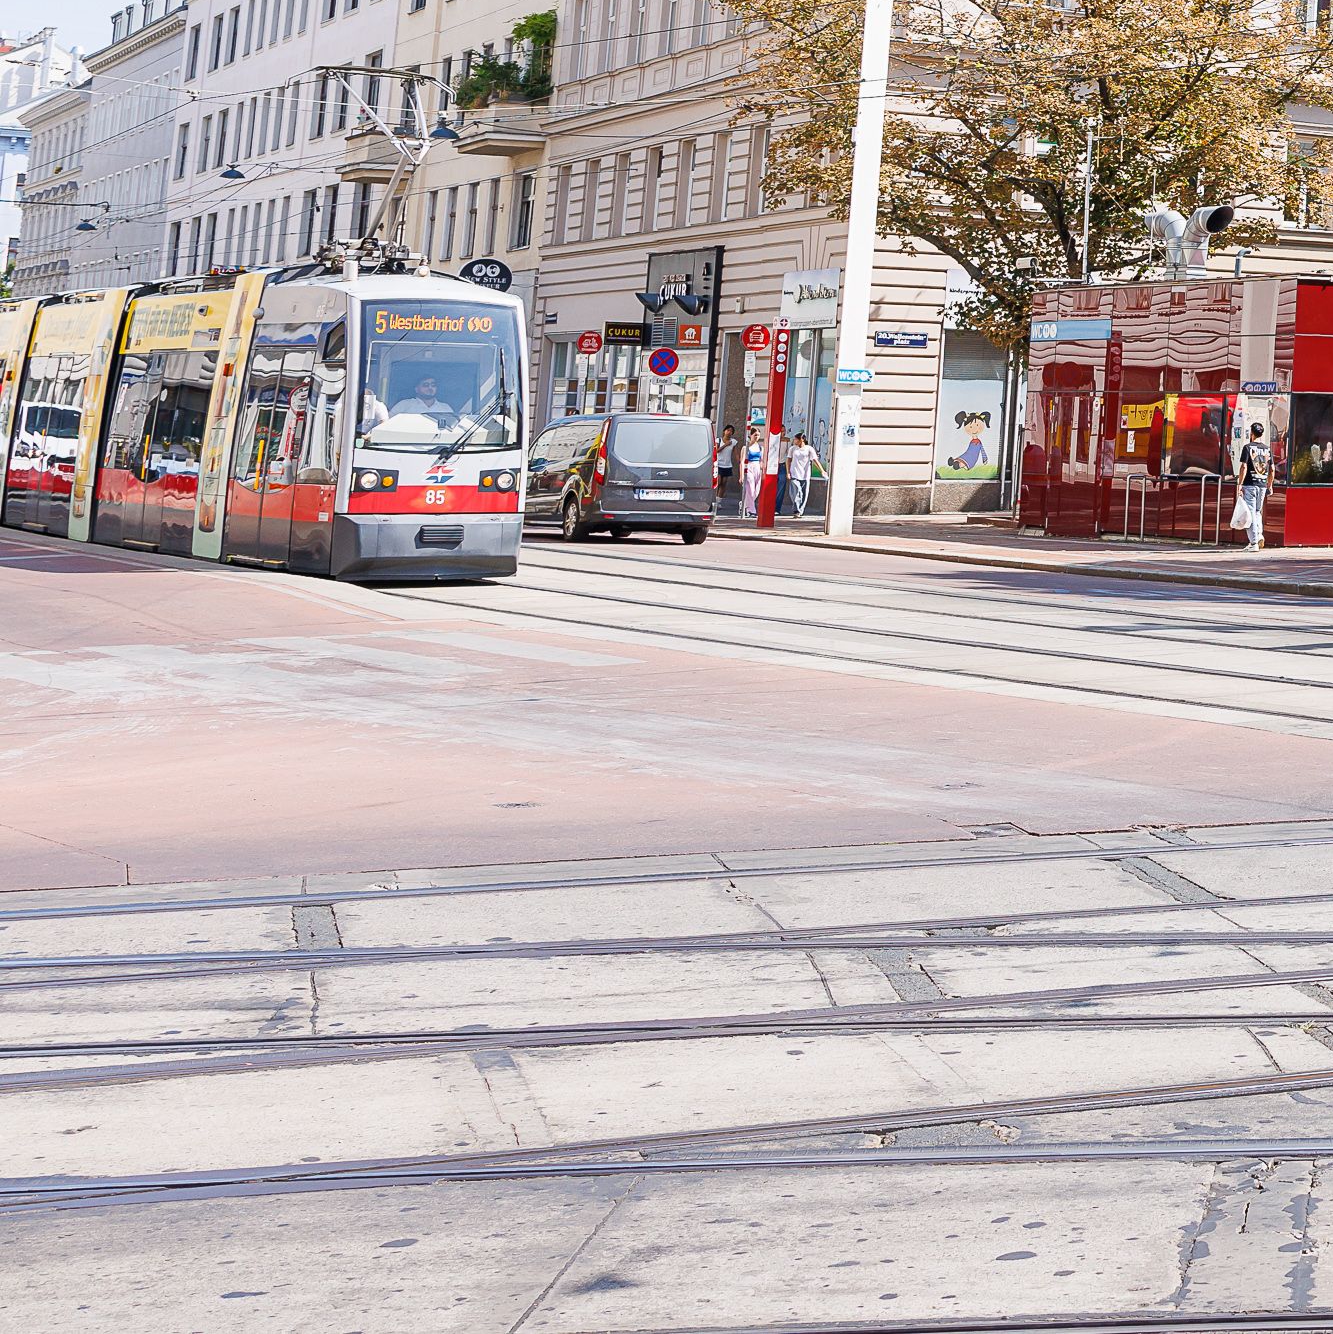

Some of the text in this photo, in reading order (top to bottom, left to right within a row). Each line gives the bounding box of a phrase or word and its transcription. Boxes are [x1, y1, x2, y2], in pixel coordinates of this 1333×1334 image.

[375, 310, 388, 334] 5
[389, 314, 465, 332] Westbahnhof
[608, 328, 640, 337] ÇUKUR
[1031, 323, 1045, 339] WC
[840, 370, 852, 381] WC
[425, 489, 446, 505] 85
